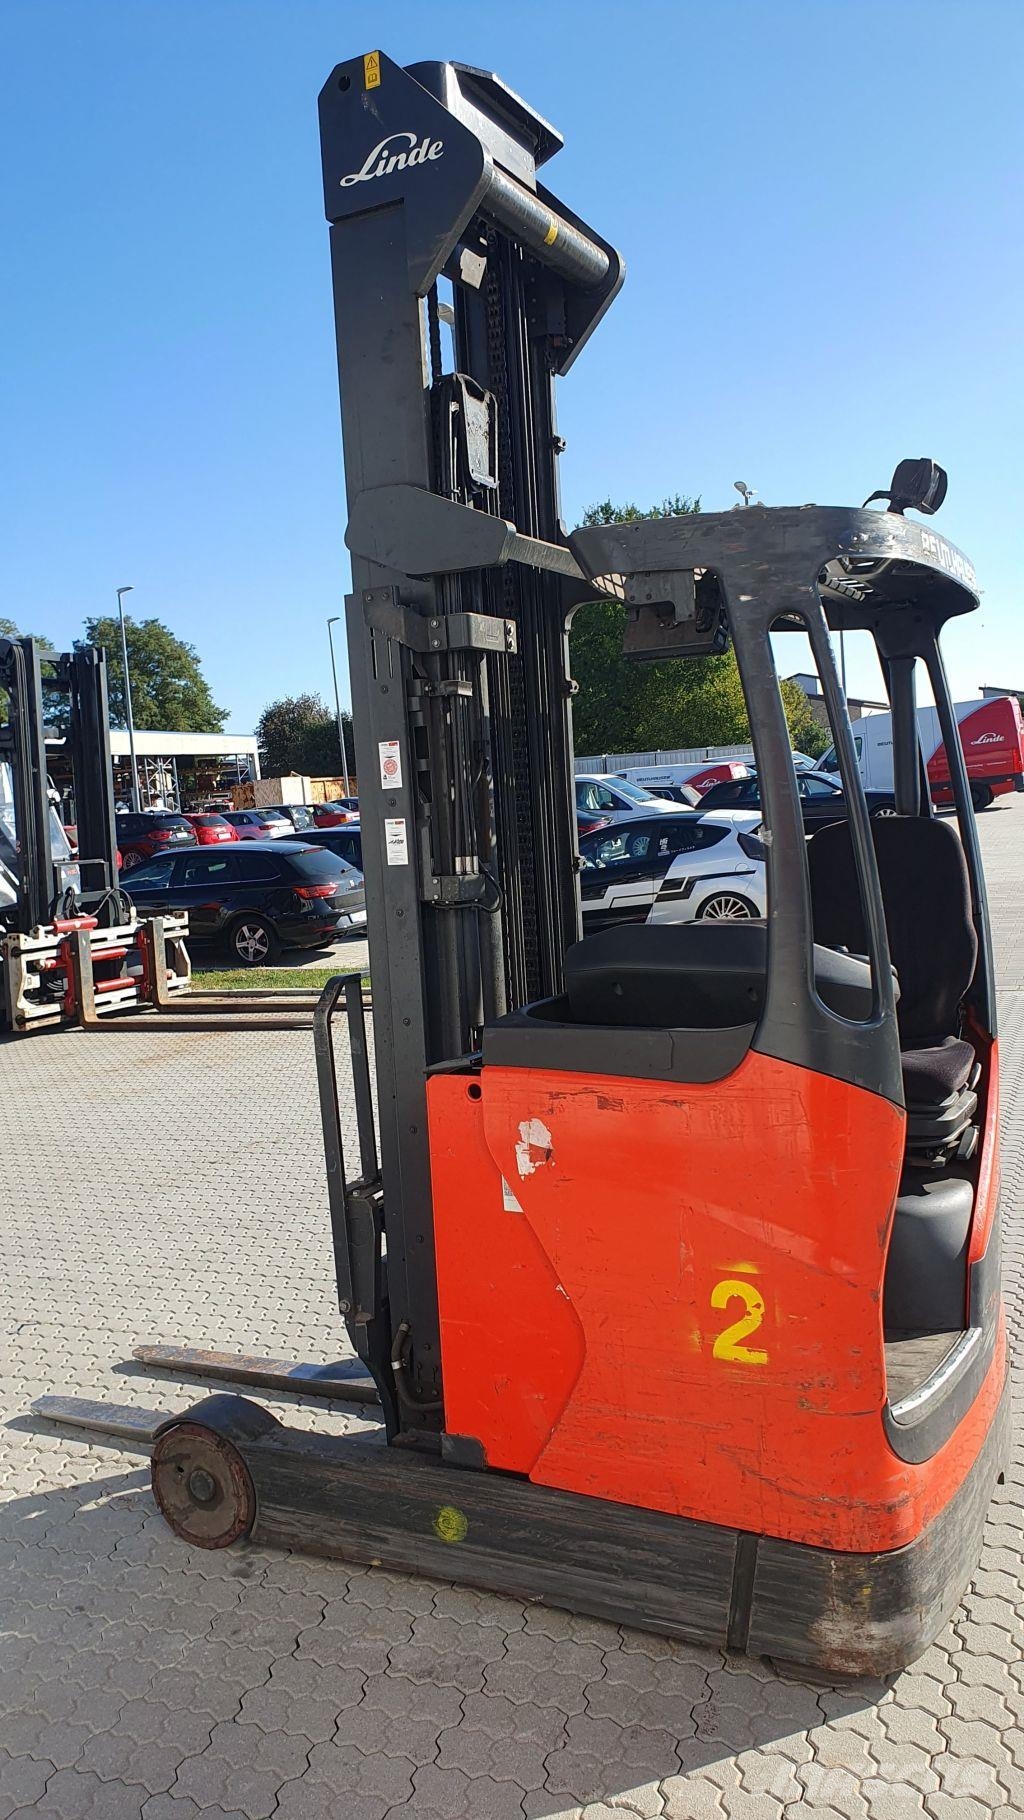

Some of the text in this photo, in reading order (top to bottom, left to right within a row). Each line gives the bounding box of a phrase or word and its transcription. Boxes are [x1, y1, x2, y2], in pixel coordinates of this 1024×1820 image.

[340, 132, 444, 187] Linde
[970, 733, 1005, 744] Linde
[711, 1280, 768, 1365] 2
